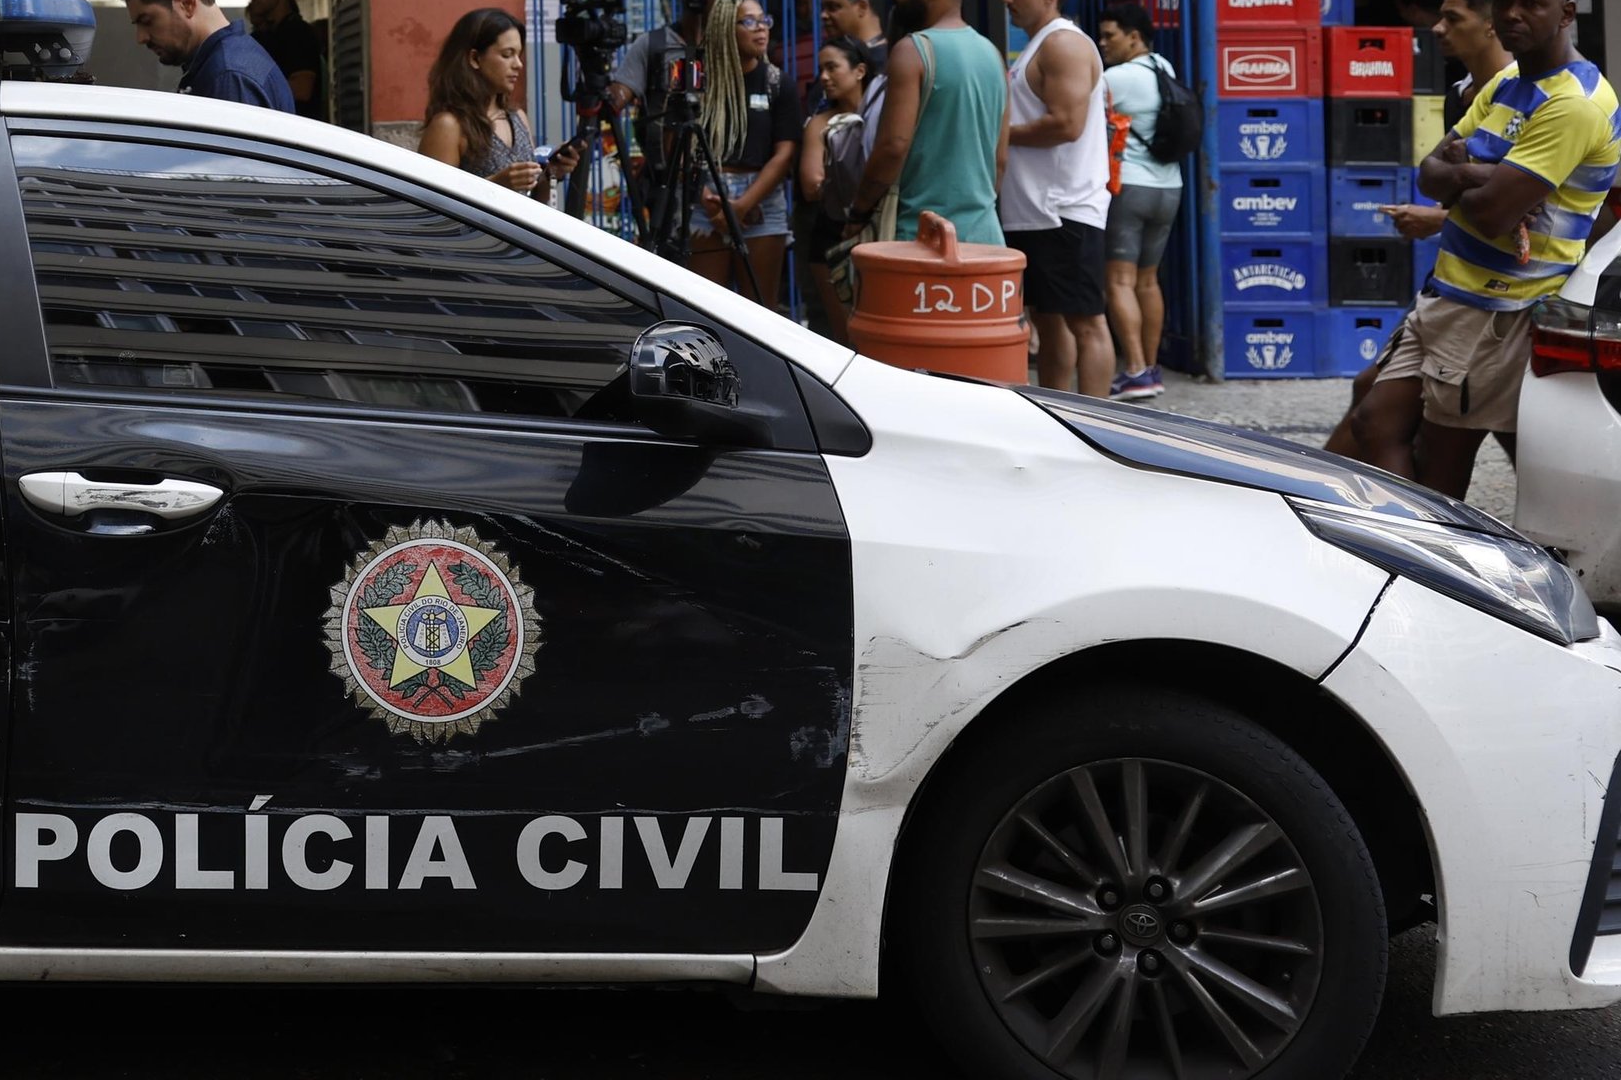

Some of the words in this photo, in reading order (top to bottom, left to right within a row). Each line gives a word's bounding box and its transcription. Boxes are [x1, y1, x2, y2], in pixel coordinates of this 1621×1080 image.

[1230, 61, 1291, 76] BRAHMA
[1349, 60, 1394, 78] BRAHMA
[1239, 120, 1288, 135] ambev
[1232, 193, 1297, 211] ambev
[912, 281, 962, 314] 12
[1245, 331, 1294, 345] ambev
[405, 602, 421, 618] CIVIL
[421, 598, 433, 606] DO
[435, 598, 449, 607] RIO
[449, 605, 460, 616] DE
[456, 616, 467, 650] JANEIRO
[13, 794, 477, 891] POLÍCIA
[516, 814, 820, 893] CIVIL
